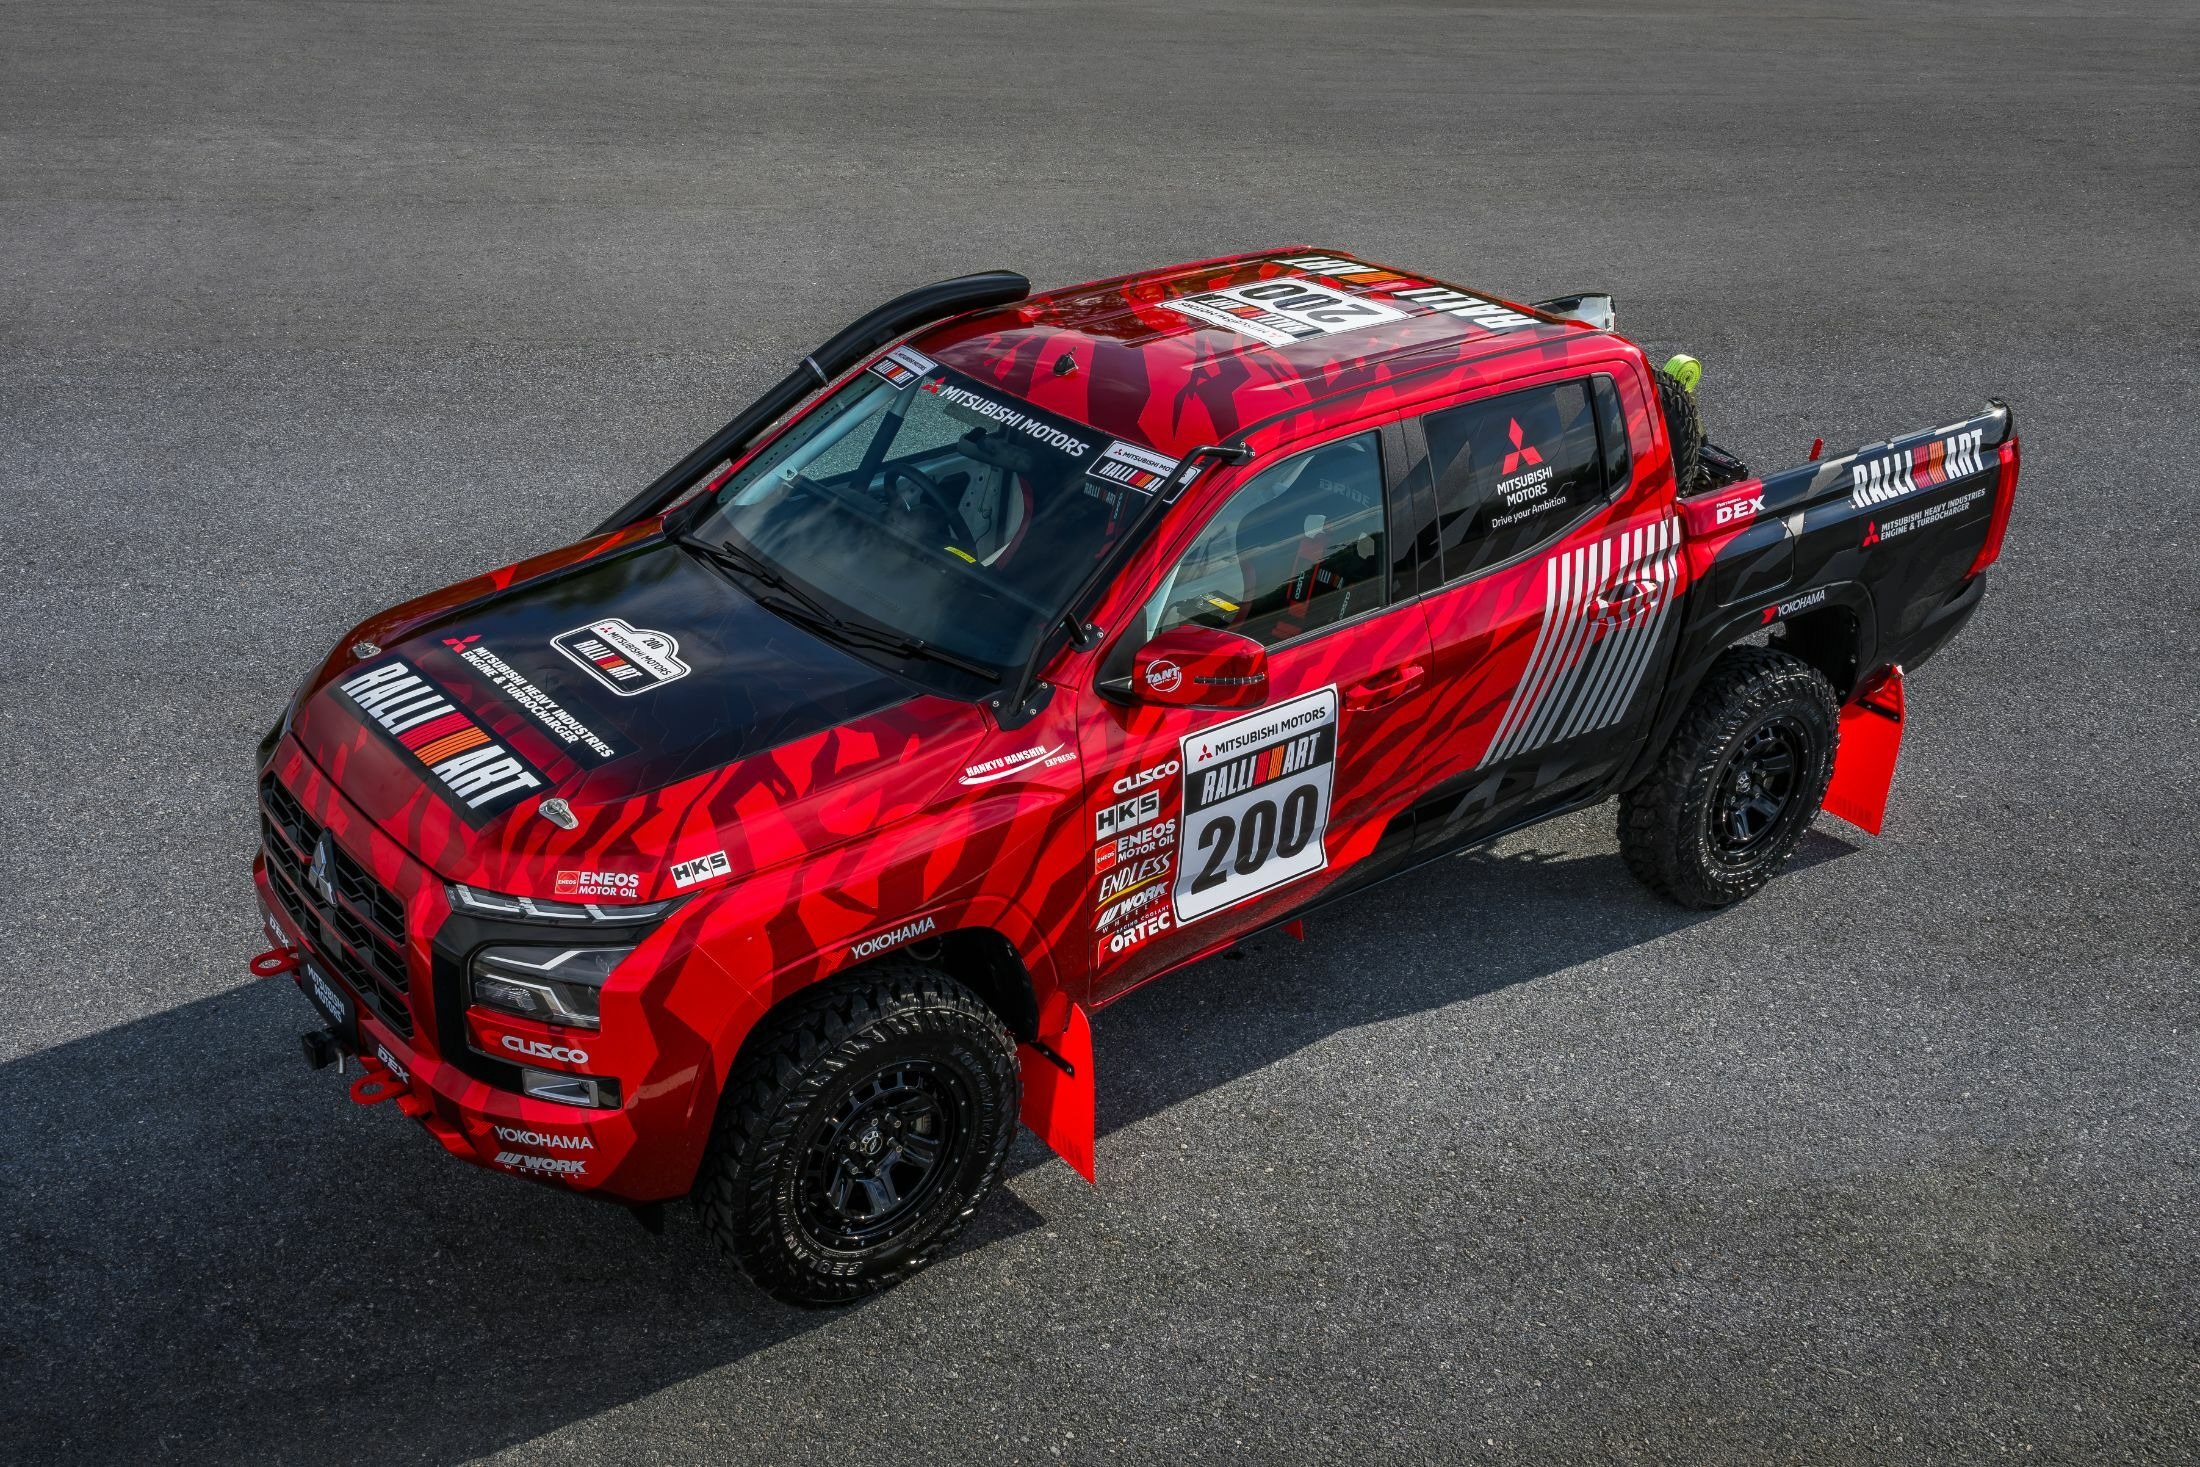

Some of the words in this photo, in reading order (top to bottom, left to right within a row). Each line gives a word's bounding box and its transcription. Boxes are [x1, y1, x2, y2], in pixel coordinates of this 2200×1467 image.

[1239, 283, 1383, 323] 200
[940, 385, 1025, 427] MITSUBISHI
[1018, 418, 1090, 457] MOTORS
[1122, 451, 1159, 468] MITSUBISHI
[1497, 466, 1553, 495] MITSUBISHI
[1506, 482, 1548, 507] MOTORS
[1491, 515, 1513, 528] Drive
[1514, 508, 1531, 524] your
[1531, 495, 1566, 514] Ambition
[1716, 495, 1766, 525] DEX
[1880, 526, 1908, 541] ENGINE
[1909, 522, 1916, 530] &
[1916, 502, 1970, 528] TURBOCHARGER
[1881, 511, 1922, 532] MITSUBISHI
[1924, 501, 1947, 518] HEAVY
[1947, 488, 1986, 508] INDUSTRIES
[1778, 589, 1825, 616] YOKOHAMA
[608, 631, 645, 660] MITSUBISHI
[644, 655, 673, 676] MOTORS
[641, 637, 665, 650] 200
[460, 650, 496, 678] ENGINE
[492, 675, 504, 685] &
[502, 682, 580, 744] TURBOCHARGER
[472, 646, 528, 689] MITSUBISHI
[521, 684, 559, 710] HEAVY
[552, 706, 616, 759] INDUSTRIES
[1214, 723, 1279, 756] MITSUBISHI
[1281, 706, 1326, 732] MOTORS
[965, 757, 1005, 777] HANKYU
[1003, 745, 1048, 765] HANSHIN
[1045, 752, 1077, 768] EXPRESS
[1113, 760, 1180, 794] CUSCO
[1097, 792, 1158, 831] HKS
[1117, 818, 1176, 853] ENEOS
[1117, 841, 1156, 863] MOTOR
[1158, 834, 1175, 847] OIL
[1190, 783, 1319, 896] 200
[579, 871, 640, 888] ENEOS
[672, 852, 728, 881] HKS
[1098, 850, 1174, 902] ENDLESS
[578, 885, 617, 896] MOTOR
[619, 888, 638, 898] OIL
[1121, 881, 1170, 915] WORK
[1102, 899, 1159, 934] WHEELS
[1140, 905, 1170, 921] COOLANT
[269, 915, 290, 950] DEX
[851, 916, 936, 960] YOKOHAMA
[1110, 911, 1171, 953] ORTEC
[307, 963, 345, 1015] MITSUBISHI
[314, 983, 343, 1024] MOTORS
[377, 1047, 410, 1085] DEX
[501, 1035, 589, 1064] CUSCO
[494, 1125, 594, 1150] YOKOHAMA
[504, 1164, 579, 1179] WHEELS
[522, 1155, 587, 1173] WORK
